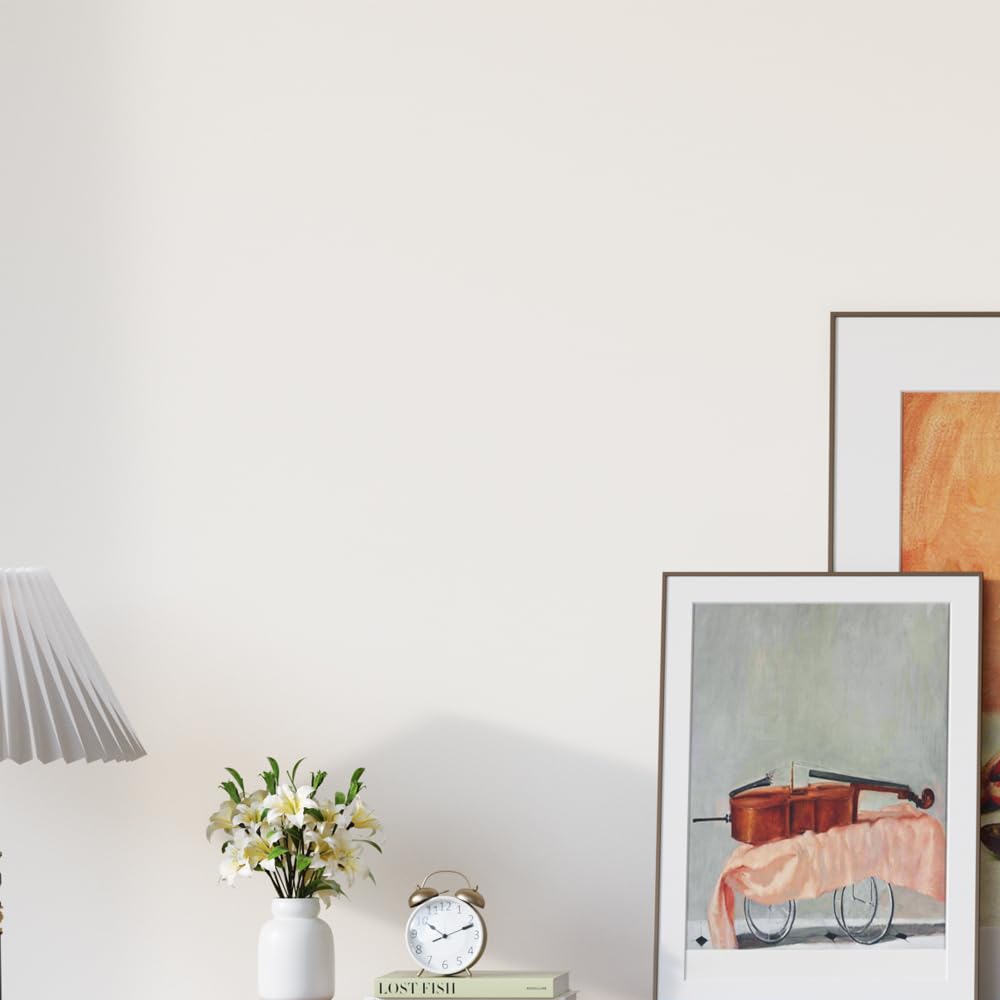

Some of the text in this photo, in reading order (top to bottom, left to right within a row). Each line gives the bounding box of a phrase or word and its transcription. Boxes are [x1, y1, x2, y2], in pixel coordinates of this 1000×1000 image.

[427, 905, 438, 914] 11
[440, 901, 452, 912] 12
[457, 904, 462, 914] 1
[411, 929, 418, 938] 9
[474, 930, 480, 940] 3
[415, 944, 422, 954] 8
[468, 946, 474, 954] 4
[426, 955, 433, 965] 7
[442, 960, 448, 970] 6
[456, 956, 462, 966] 5
[378, 982, 456, 995] LOST FISH
